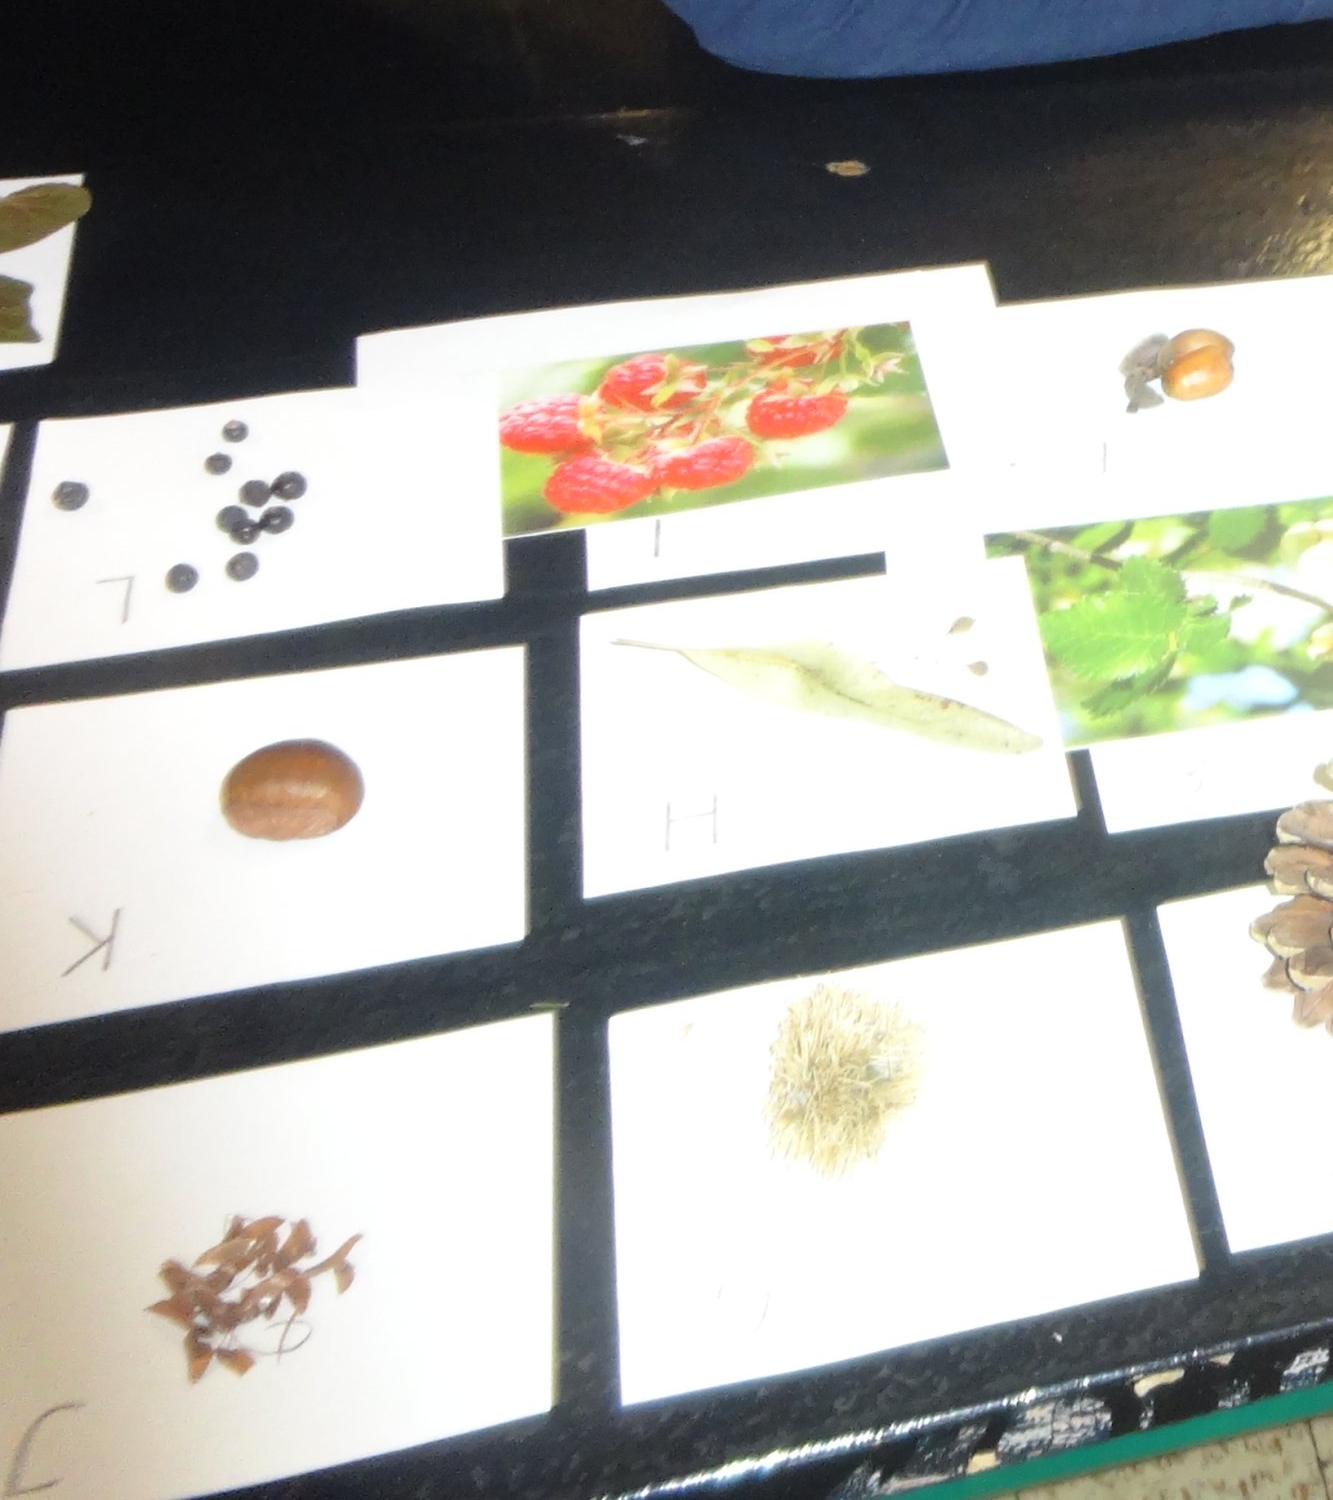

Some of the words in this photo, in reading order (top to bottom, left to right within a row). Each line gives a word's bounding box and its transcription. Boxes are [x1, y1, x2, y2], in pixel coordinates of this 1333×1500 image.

[95, 576, 136, 625] L
[664, 795, 719, 853] H
[60, 907, 123, 978] K
[3, 1403, 84, 1498] J
